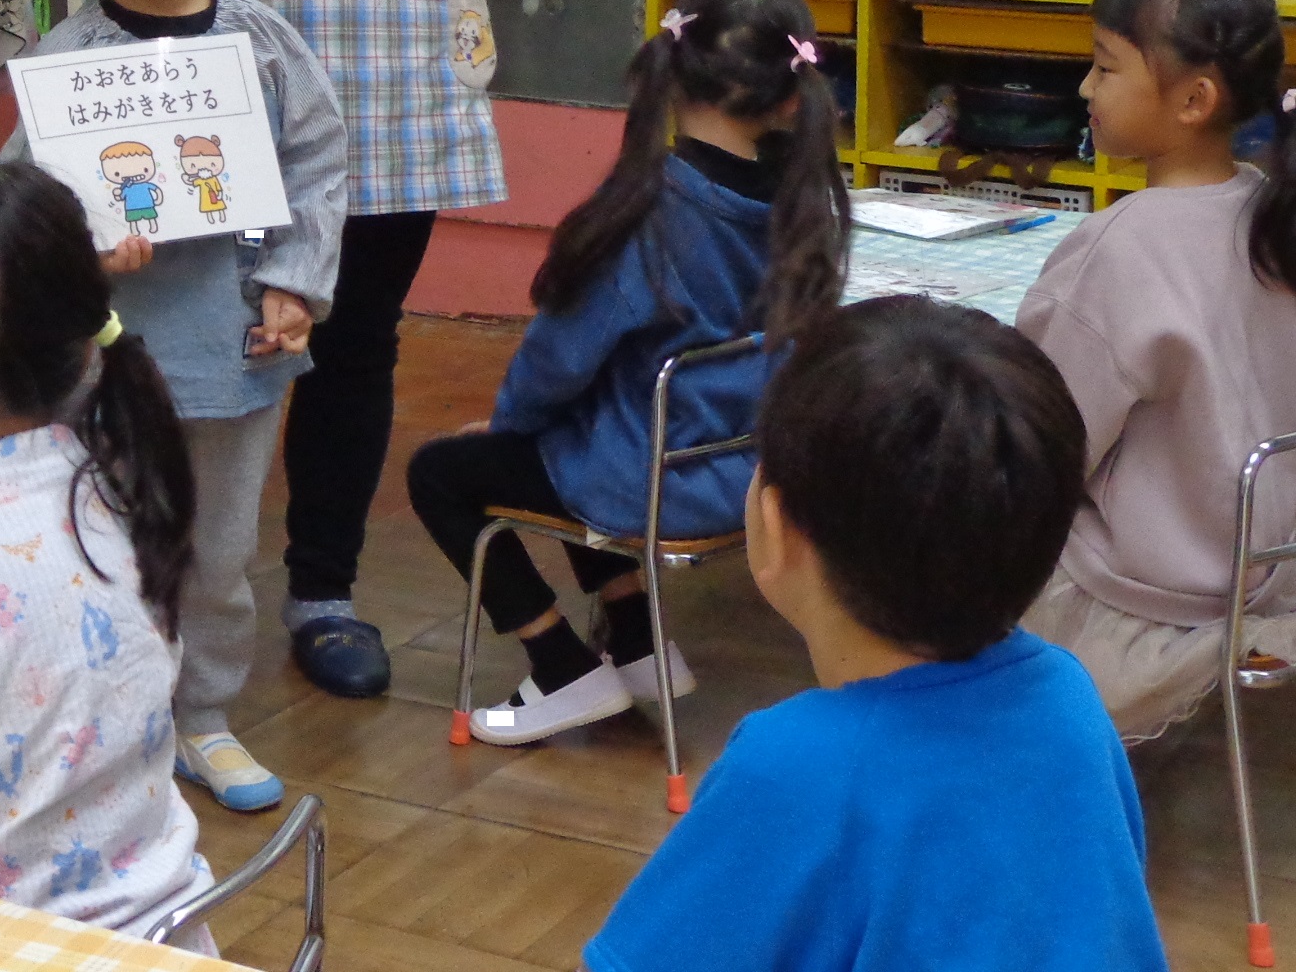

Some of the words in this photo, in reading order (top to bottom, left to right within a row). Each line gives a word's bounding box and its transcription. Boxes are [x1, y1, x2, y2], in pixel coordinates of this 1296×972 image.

[70, 57, 199, 93] かおをあらう
[67, 89, 219, 127] はみがきをする
